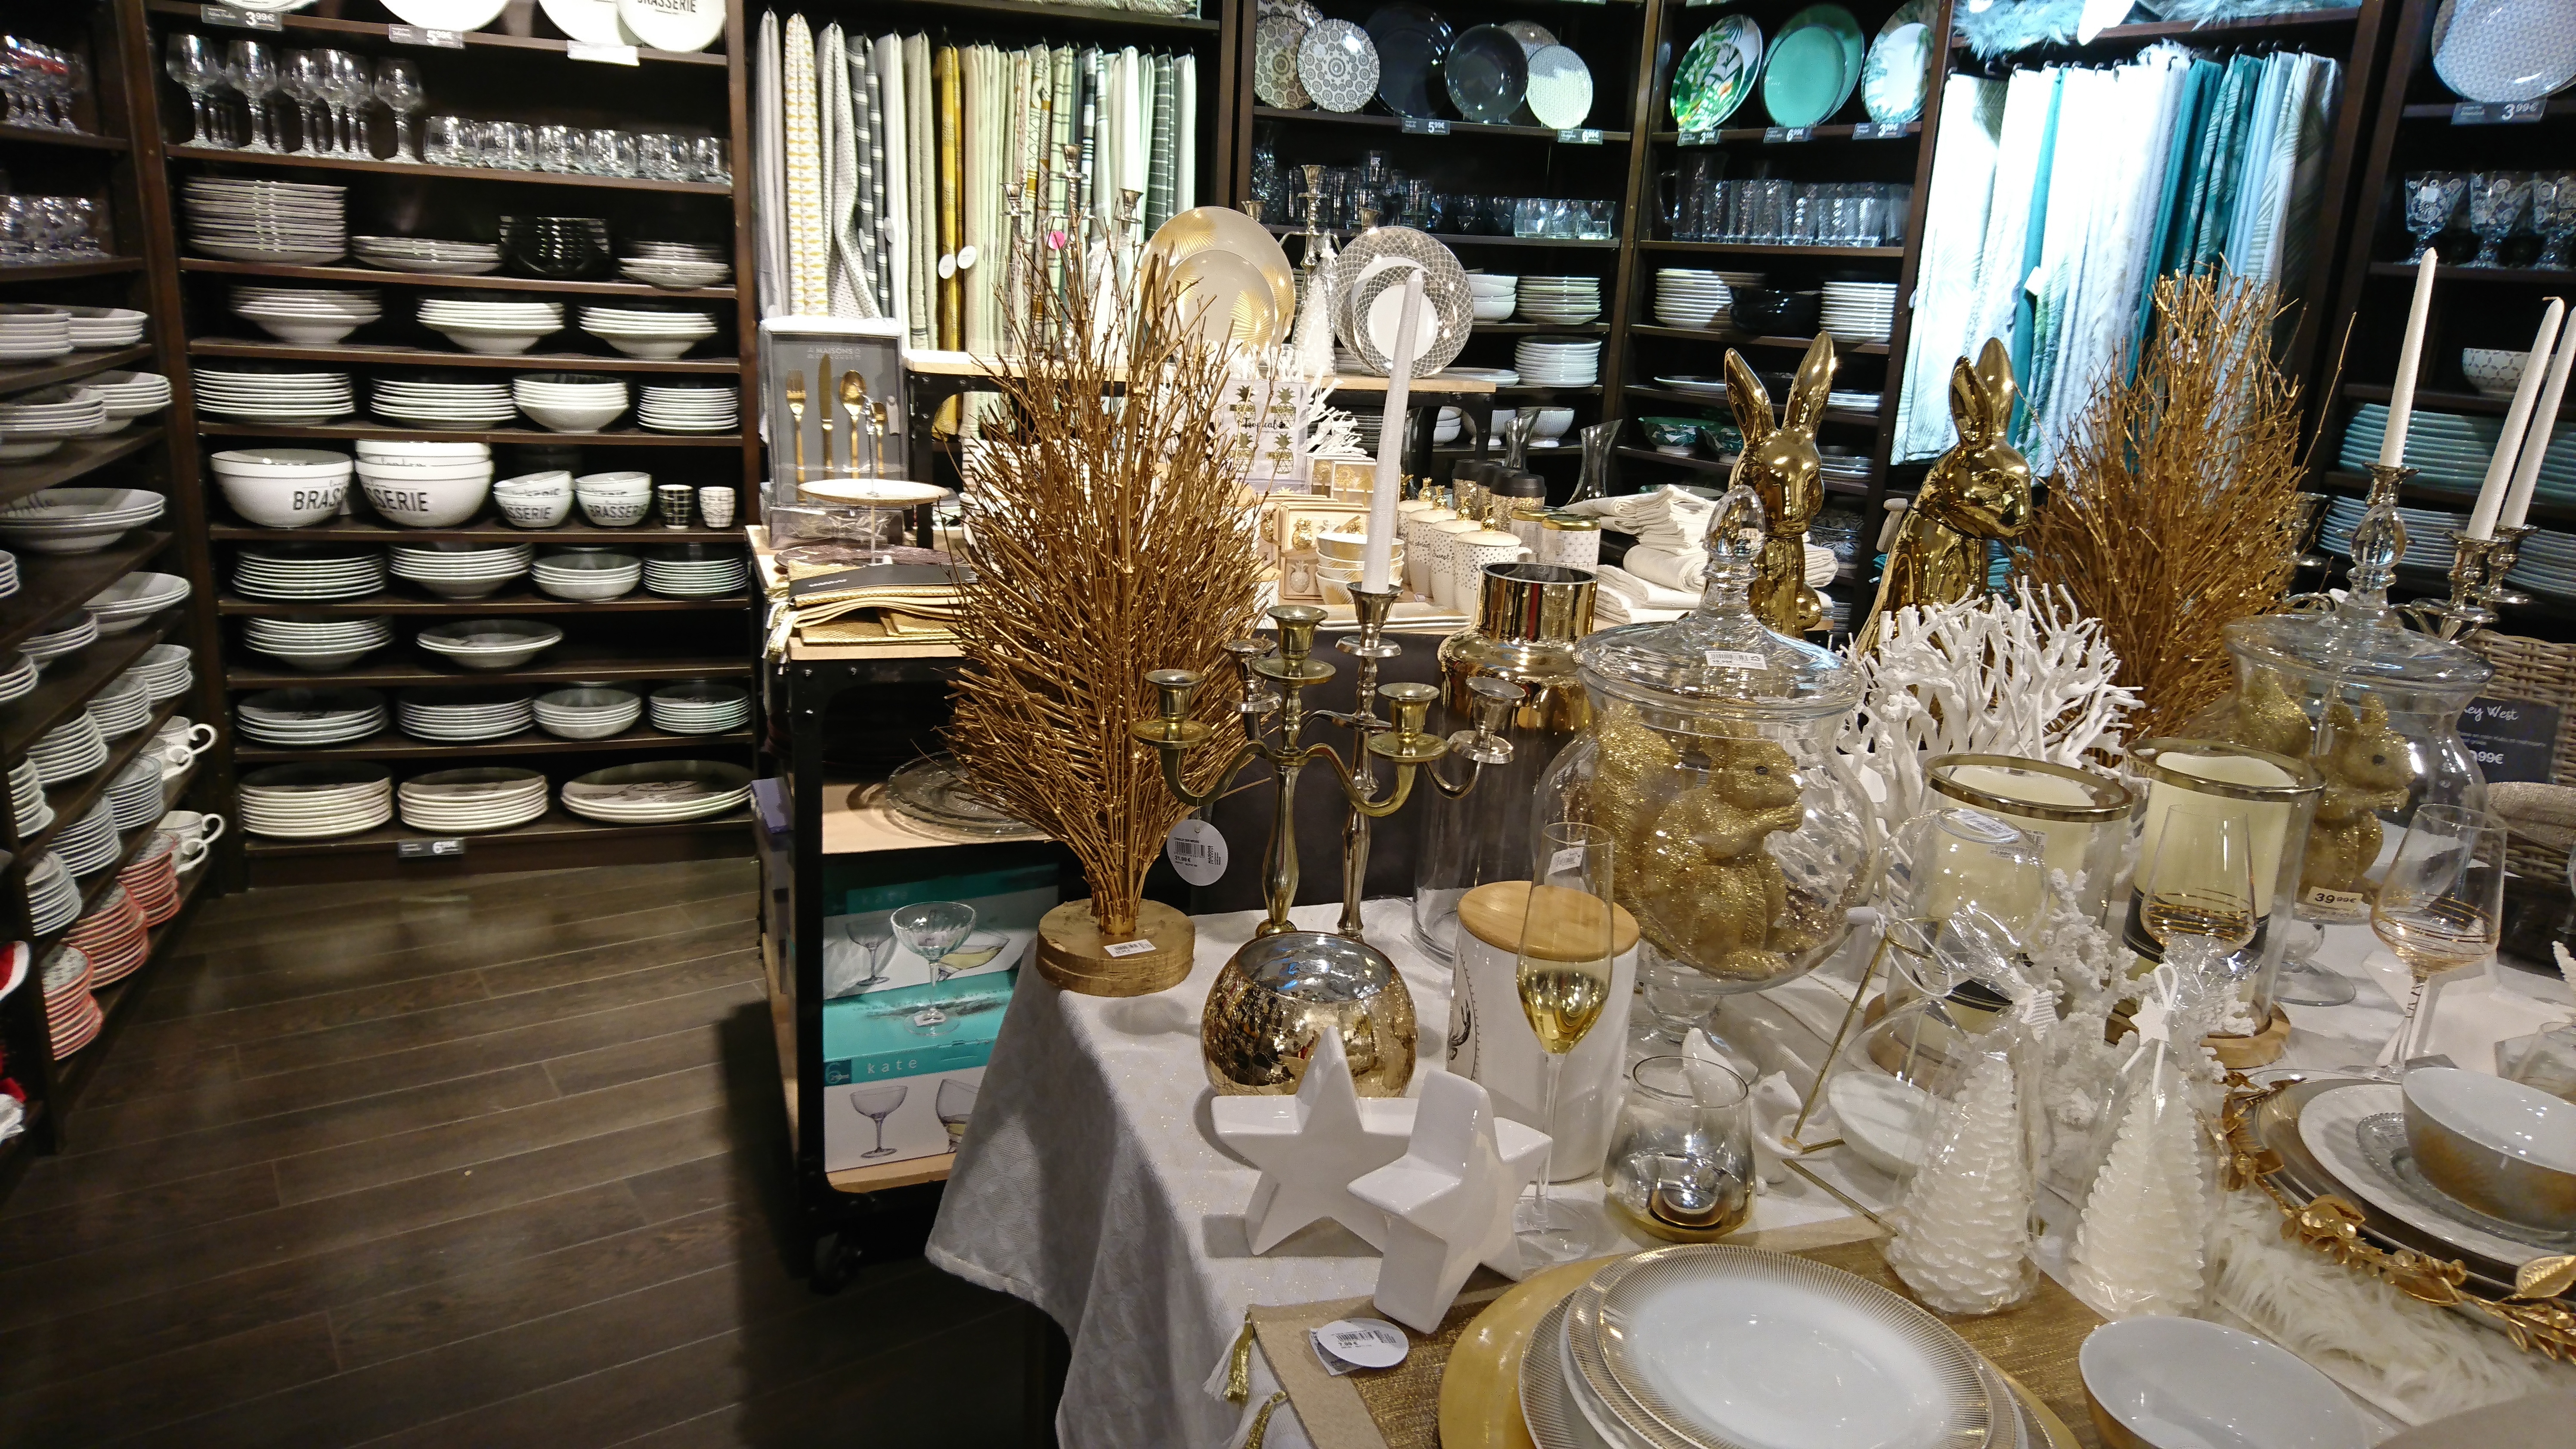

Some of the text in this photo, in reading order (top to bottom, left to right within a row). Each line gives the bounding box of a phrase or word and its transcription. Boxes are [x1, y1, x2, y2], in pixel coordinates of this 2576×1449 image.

[638, 0, 696, 12] ASSERIE
[1242, 417, 1278, 433] Tropcal
[2464, 705, 2518, 722] ey West
[867, 1059, 918, 1074] kate
